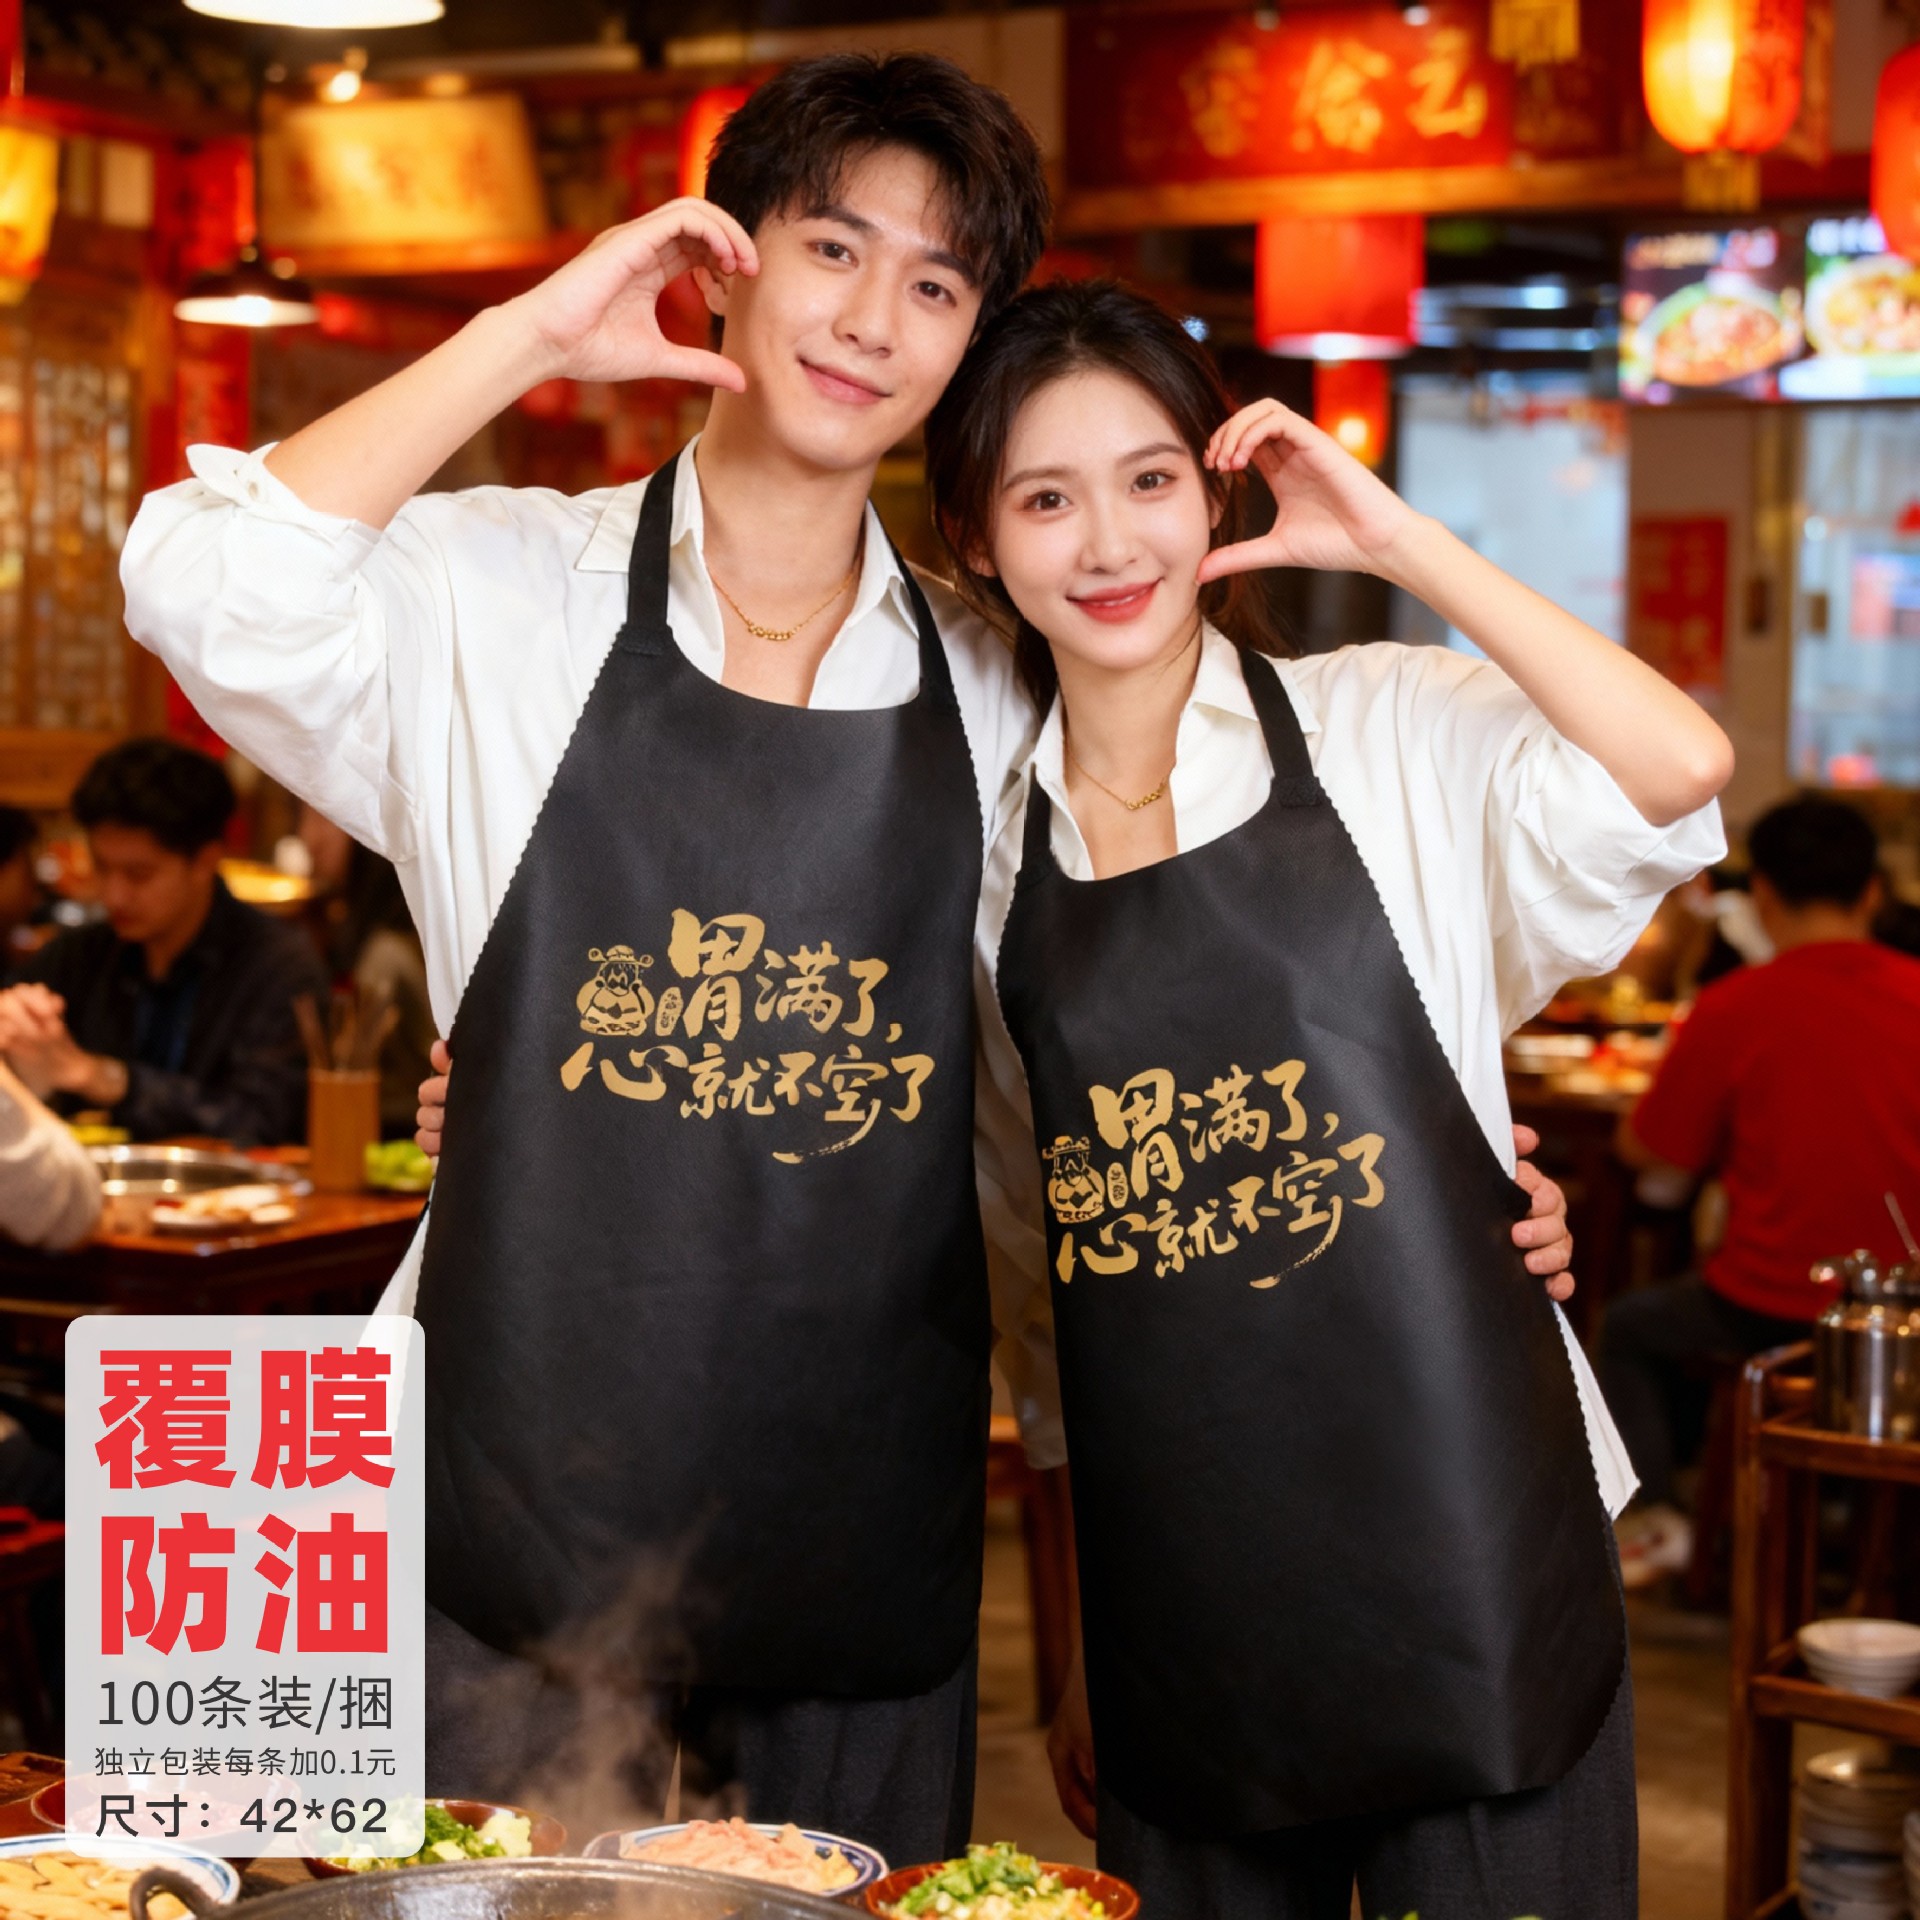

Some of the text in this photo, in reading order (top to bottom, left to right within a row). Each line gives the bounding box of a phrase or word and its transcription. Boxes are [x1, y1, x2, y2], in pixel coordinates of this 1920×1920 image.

[560, 1042, 935, 1163] 心就不空了
[1056, 1133, 1386, 1289] 心就不空了
